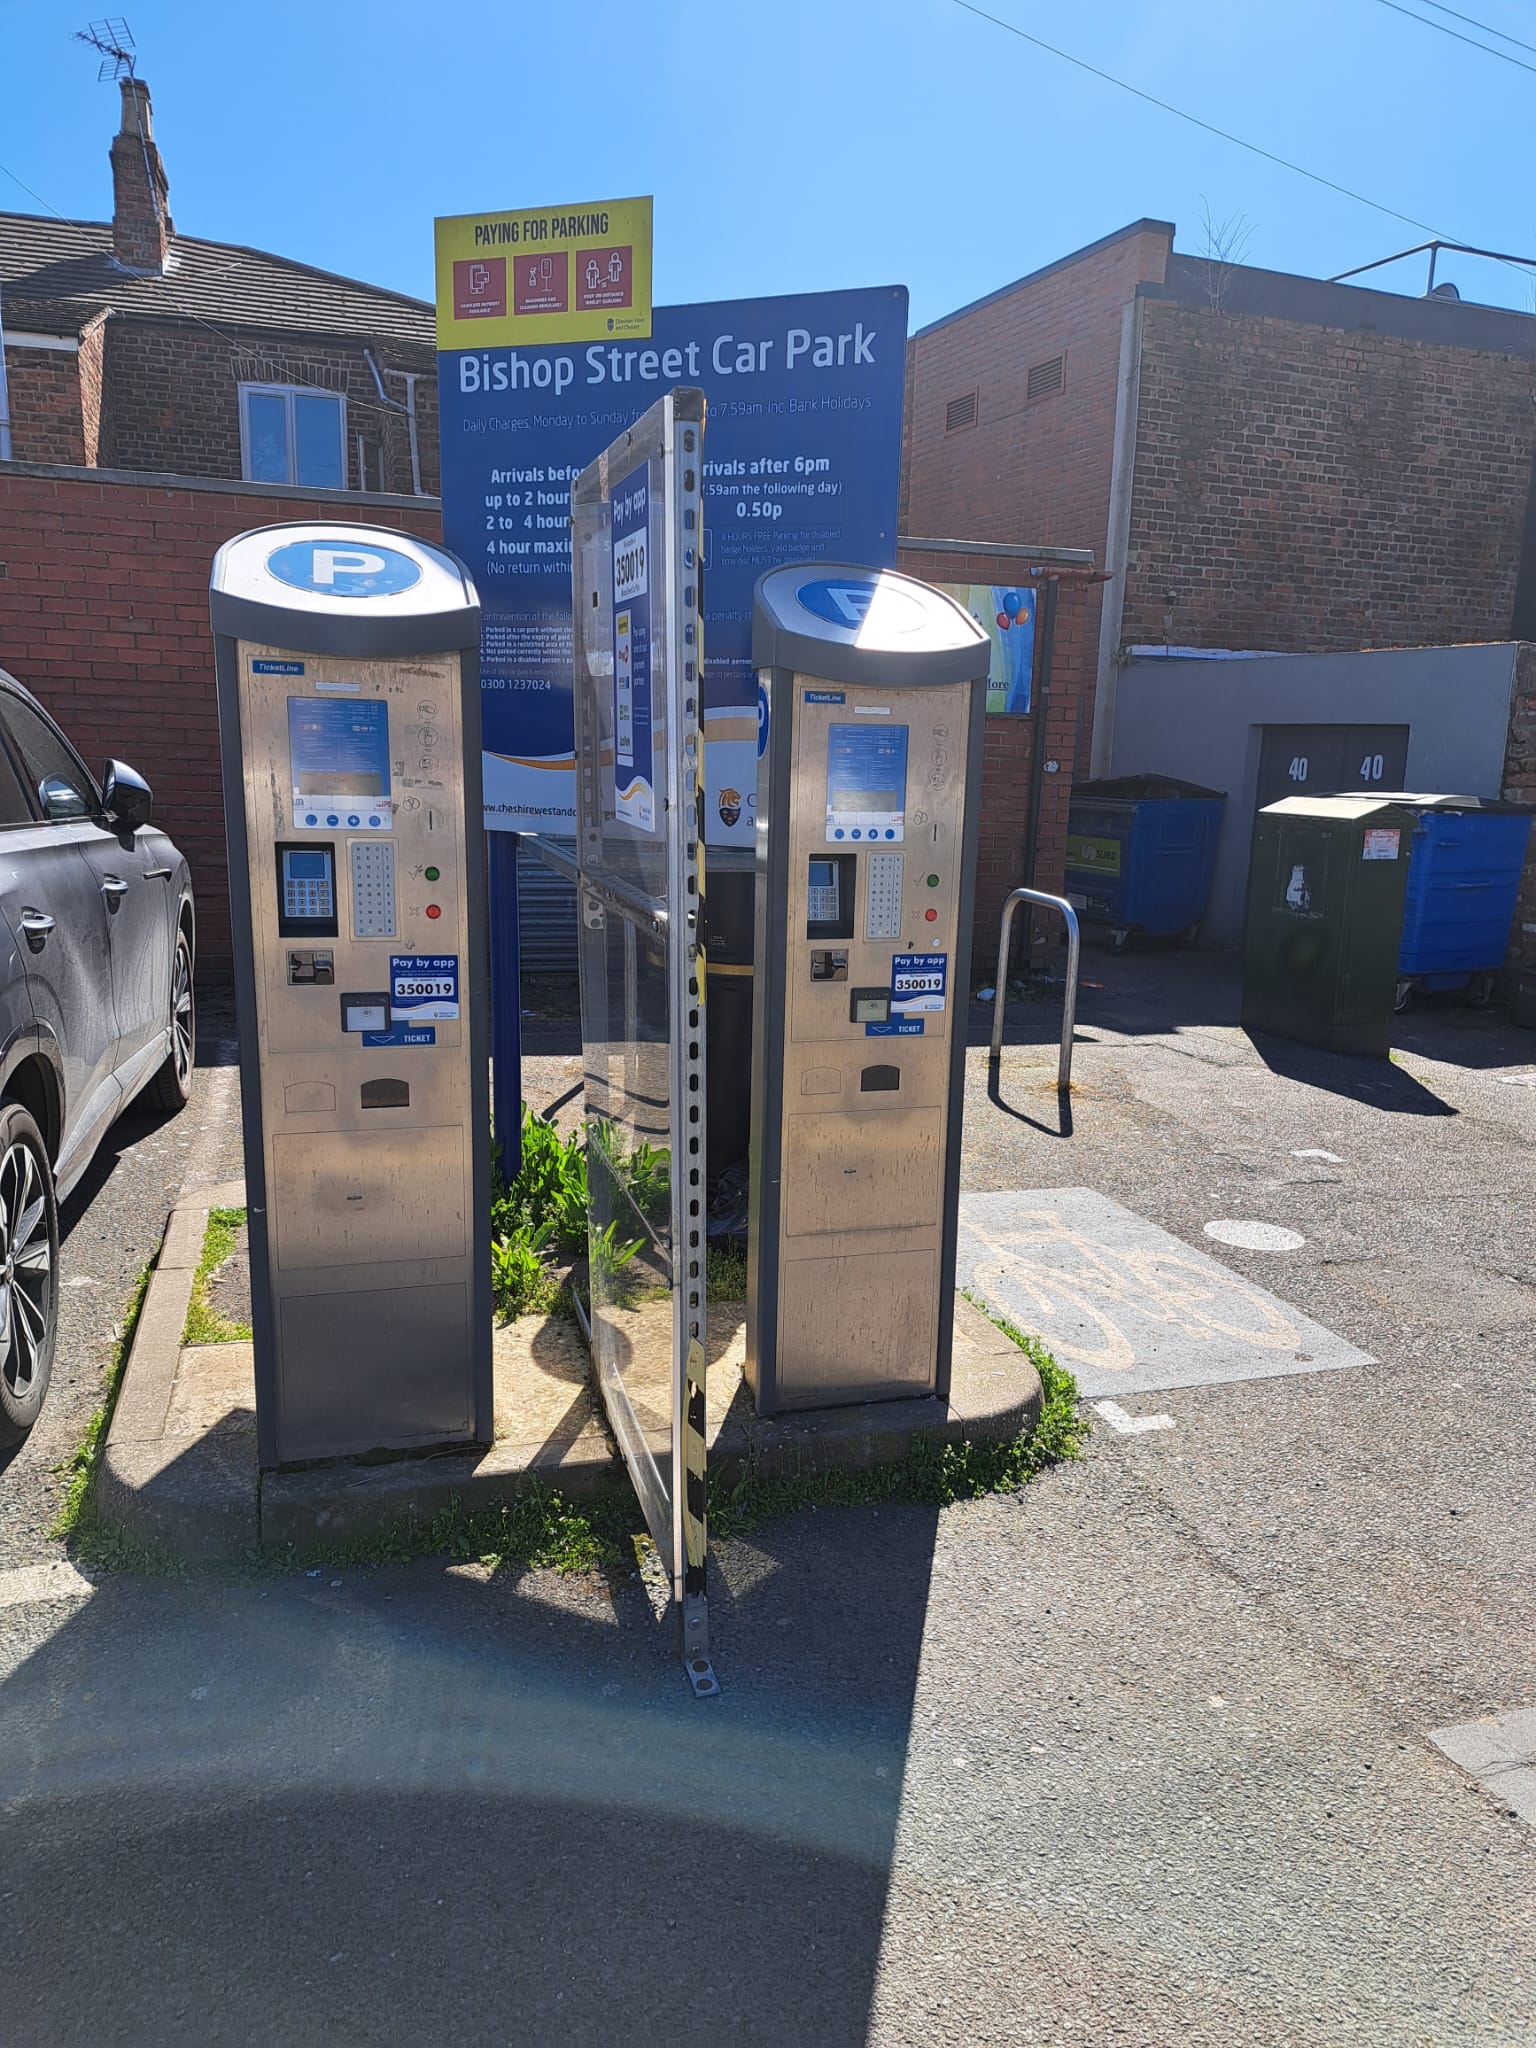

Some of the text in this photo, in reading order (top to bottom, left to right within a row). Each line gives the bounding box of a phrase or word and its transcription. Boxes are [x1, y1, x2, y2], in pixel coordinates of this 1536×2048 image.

[475, 213, 609, 246] PAYING FOR PARKING
[459, 322, 877, 396] Bishop Street Car Park
[720, 401, 763, 417] 7.59am
[768, 400, 785, 414] Inc
[789, 398, 818, 413] Bank
[821, 394, 872, 411] Holidays
[463, 419, 486, 435] Daily
[489, 417, 531, 432] Charges,
[534, 414, 574, 430] Monday
[577, 414, 587, 426] to
[590, 410, 629, 428] Sunday
[750, 457, 790, 475] after
[794, 456, 830, 476] 6pm
[491, 465, 586, 484] Arrivals befo
[742, 483, 760, 495] the
[763, 481, 815, 497] following
[818, 481, 842, 496] day)
[485, 490, 570, 511] up to 2 hour
[613, 499, 624, 527] Pay
[624, 490, 633, 520] by
[634, 486, 646, 515] app
[736, 501, 783, 520] 0.50p
[486, 514, 569, 530] 2 to 4 hour
[753, 532, 772, 541] FREE
[486, 538, 572, 555] 4 hour maxi
[313, 548, 386, 585] P
[487, 560, 505, 576] (No
[507, 562, 540, 574] return
[616, 546, 645, 587] 350019
[556, 611, 572, 621] follo
[258, 662, 299, 673] TicketLine
[480, 679, 551, 691] 0300 1237024
[810, 693, 842, 703] TicketLine
[1288, 757, 1308, 782] 40
[1360, 754, 1384, 781] 40
[392, 957, 455, 969] Pay by app
[894, 955, 945, 967] Pay by app
[397, 983, 452, 995] 350019
[896, 978, 941, 990] 350019
[898, 1025, 921, 1033] TICKET
[403, 1034, 431, 1043] TICKET
